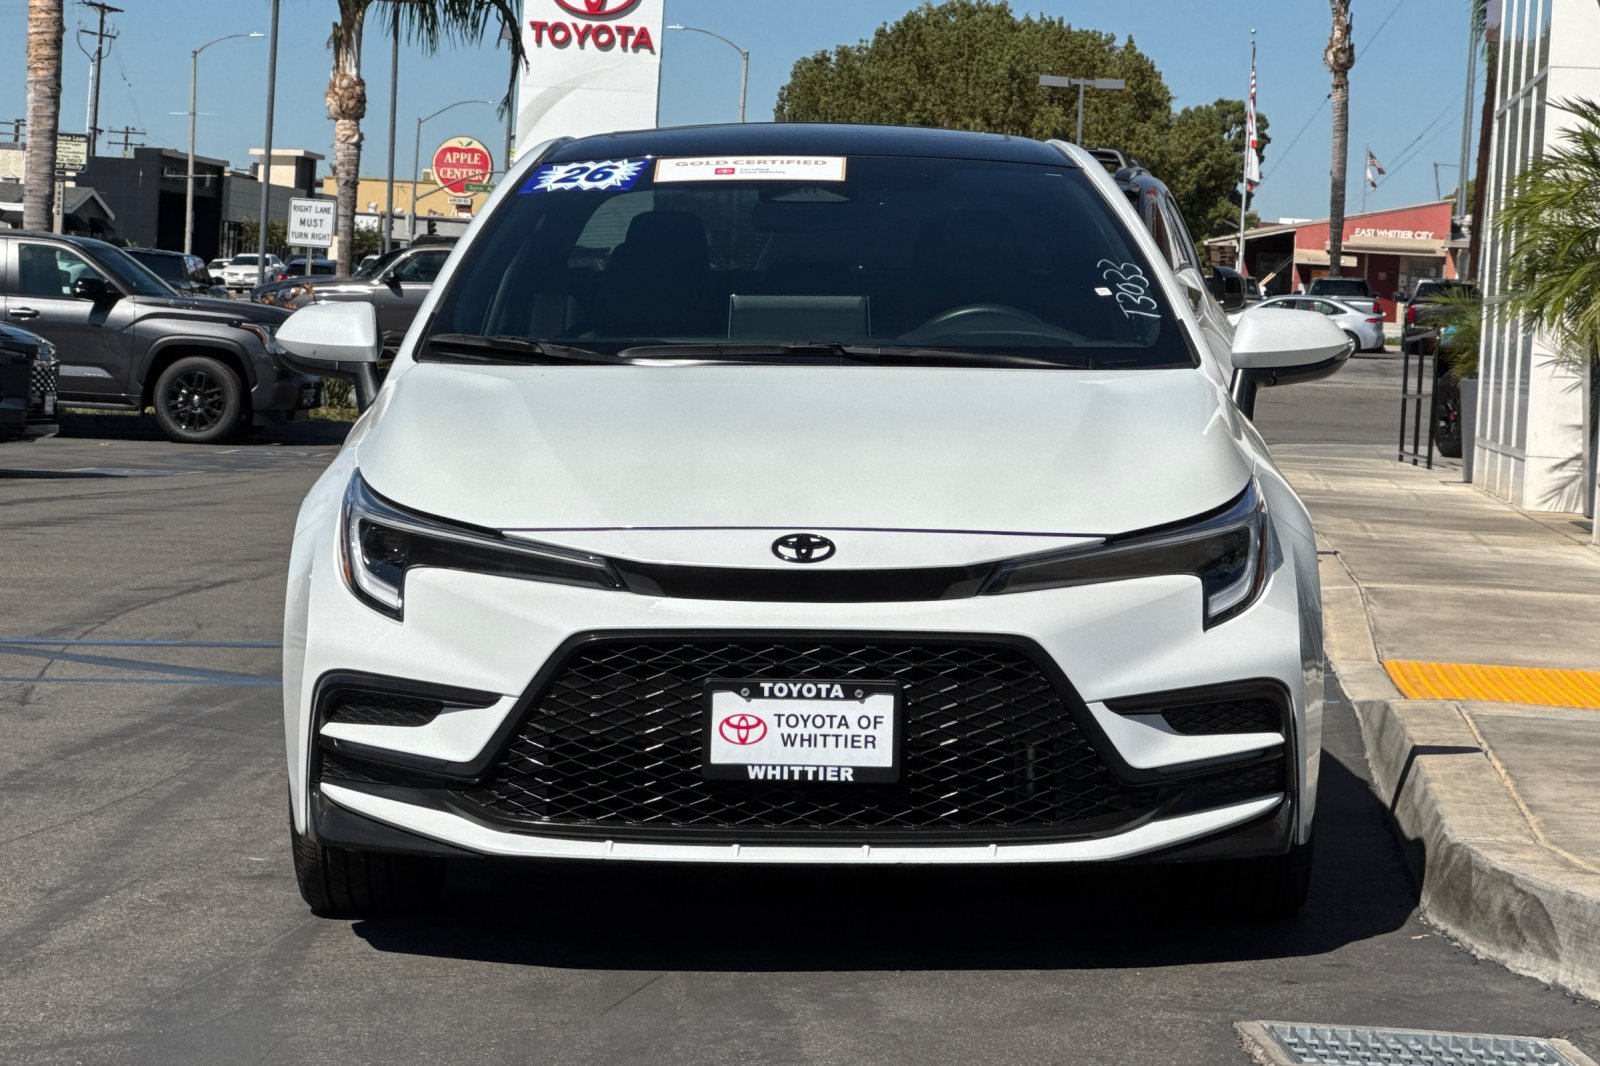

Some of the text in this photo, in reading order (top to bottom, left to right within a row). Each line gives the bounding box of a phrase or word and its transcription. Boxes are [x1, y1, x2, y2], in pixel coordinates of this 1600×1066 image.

[530, 20, 653, 50] TOYOTA
[443, 151, 482, 165] APPLE
[439, 167, 483, 181] CENTER
[549, 165, 620, 184] 26
[293, 204, 332, 215] RIGHT LANE
[299, 218, 324, 228] MUST
[291, 231, 330, 241] TURN RIGHT
[1355, 228, 1435, 240] EAST WHITTIER CITY
[759, 682, 845, 698] TOYOTA
[773, 713, 885, 730] TOYOTA OF
[780, 733, 877, 749] WHITTIER
[747, 765, 854, 782] WHITTIER
